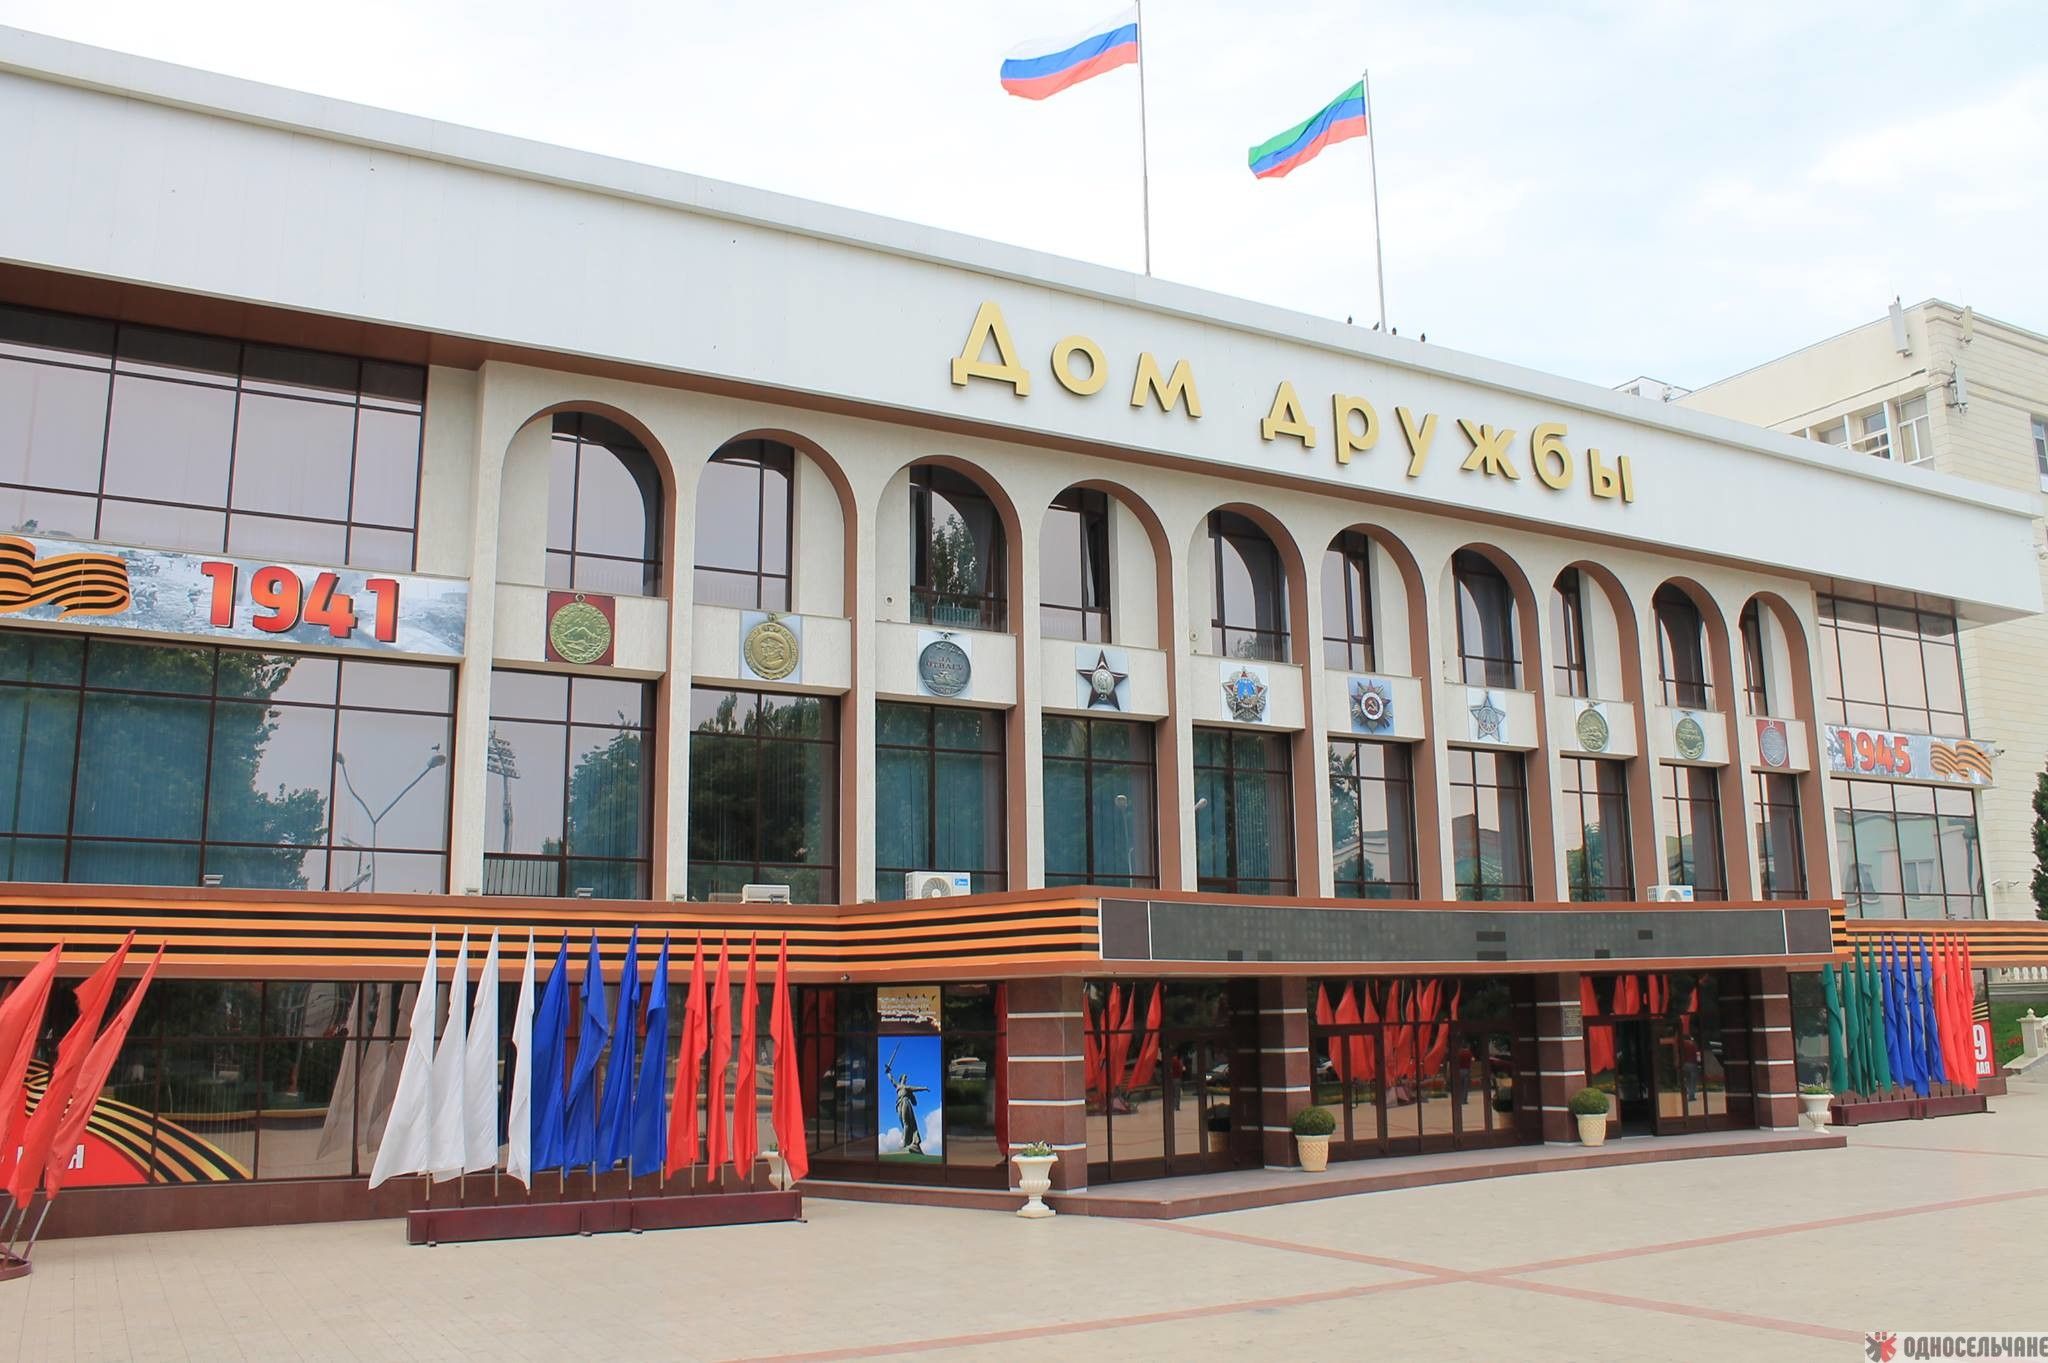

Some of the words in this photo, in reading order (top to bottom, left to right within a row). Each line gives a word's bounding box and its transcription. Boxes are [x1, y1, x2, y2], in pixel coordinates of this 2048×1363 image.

[951, 301, 1206, 419] Дом
[1261, 381, 1635, 503] дружбы
[200, 561, 400, 643] 1941
[1837, 730, 1912, 774] 1945
[1972, 1024, 1987, 1061] 9
